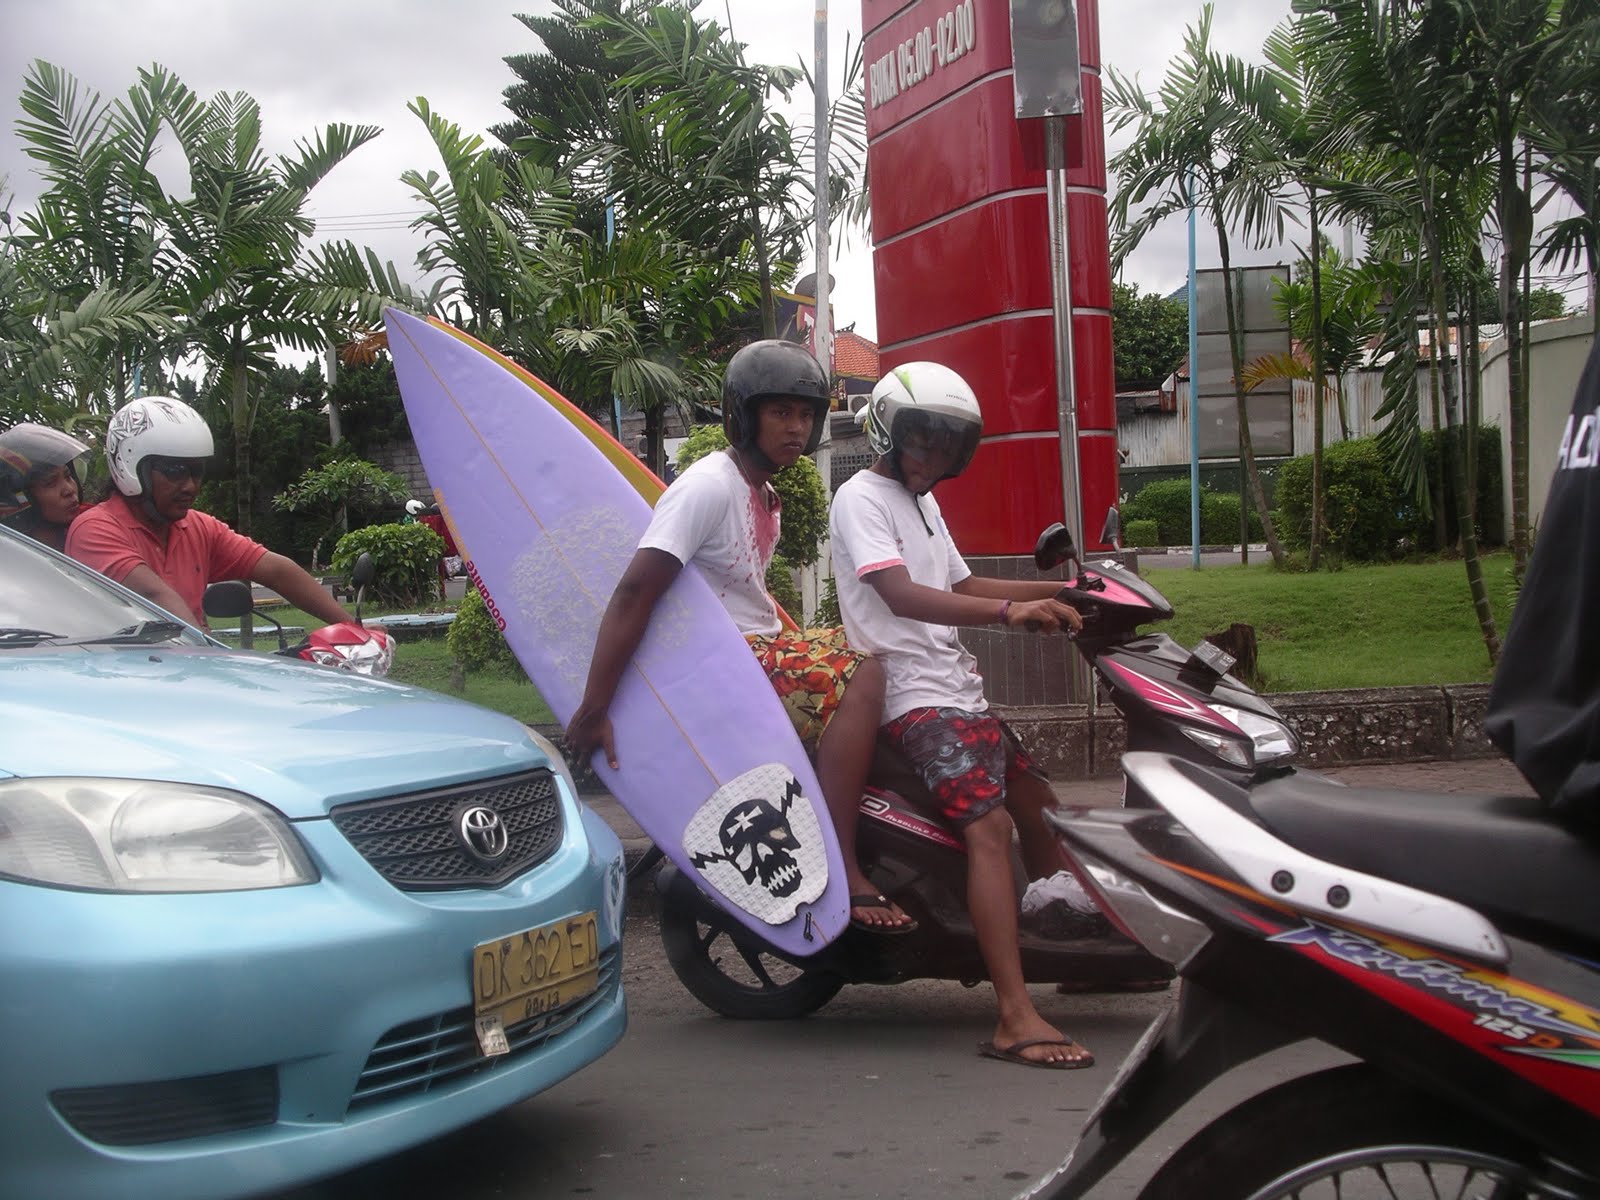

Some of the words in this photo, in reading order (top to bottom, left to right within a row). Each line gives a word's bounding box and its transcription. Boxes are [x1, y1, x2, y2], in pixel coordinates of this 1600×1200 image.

[870, 49, 899, 109] BUKA
[898, 0, 976, 91] 05.00-02.00
[479, 944, 512, 999] DK
[520, 929, 561, 985] 362
